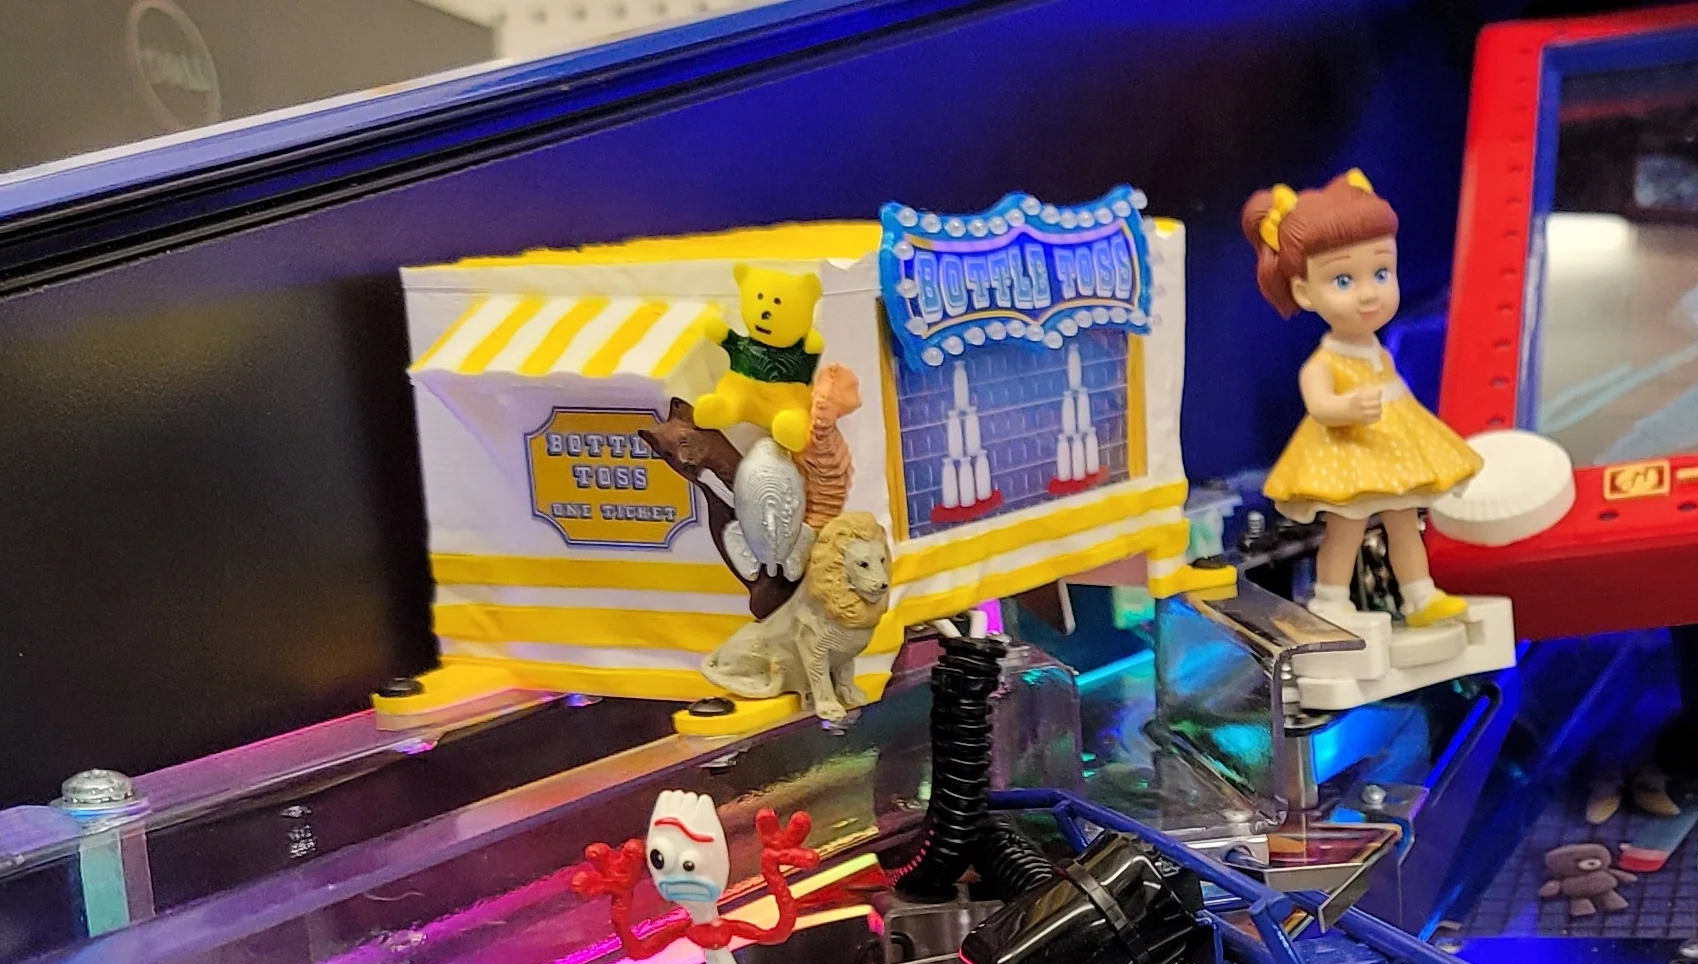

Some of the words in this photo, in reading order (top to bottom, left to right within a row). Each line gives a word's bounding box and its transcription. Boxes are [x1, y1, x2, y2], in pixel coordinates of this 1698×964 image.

[913, 243, 1051, 324] BOTTLE
[1053, 235, 1134, 300] TOSS
[546, 432, 666, 460] BOTTL
[571, 463, 648, 490] TOSS
[551, 502, 593, 519] ONE
[600, 503, 677, 523] TICKET
